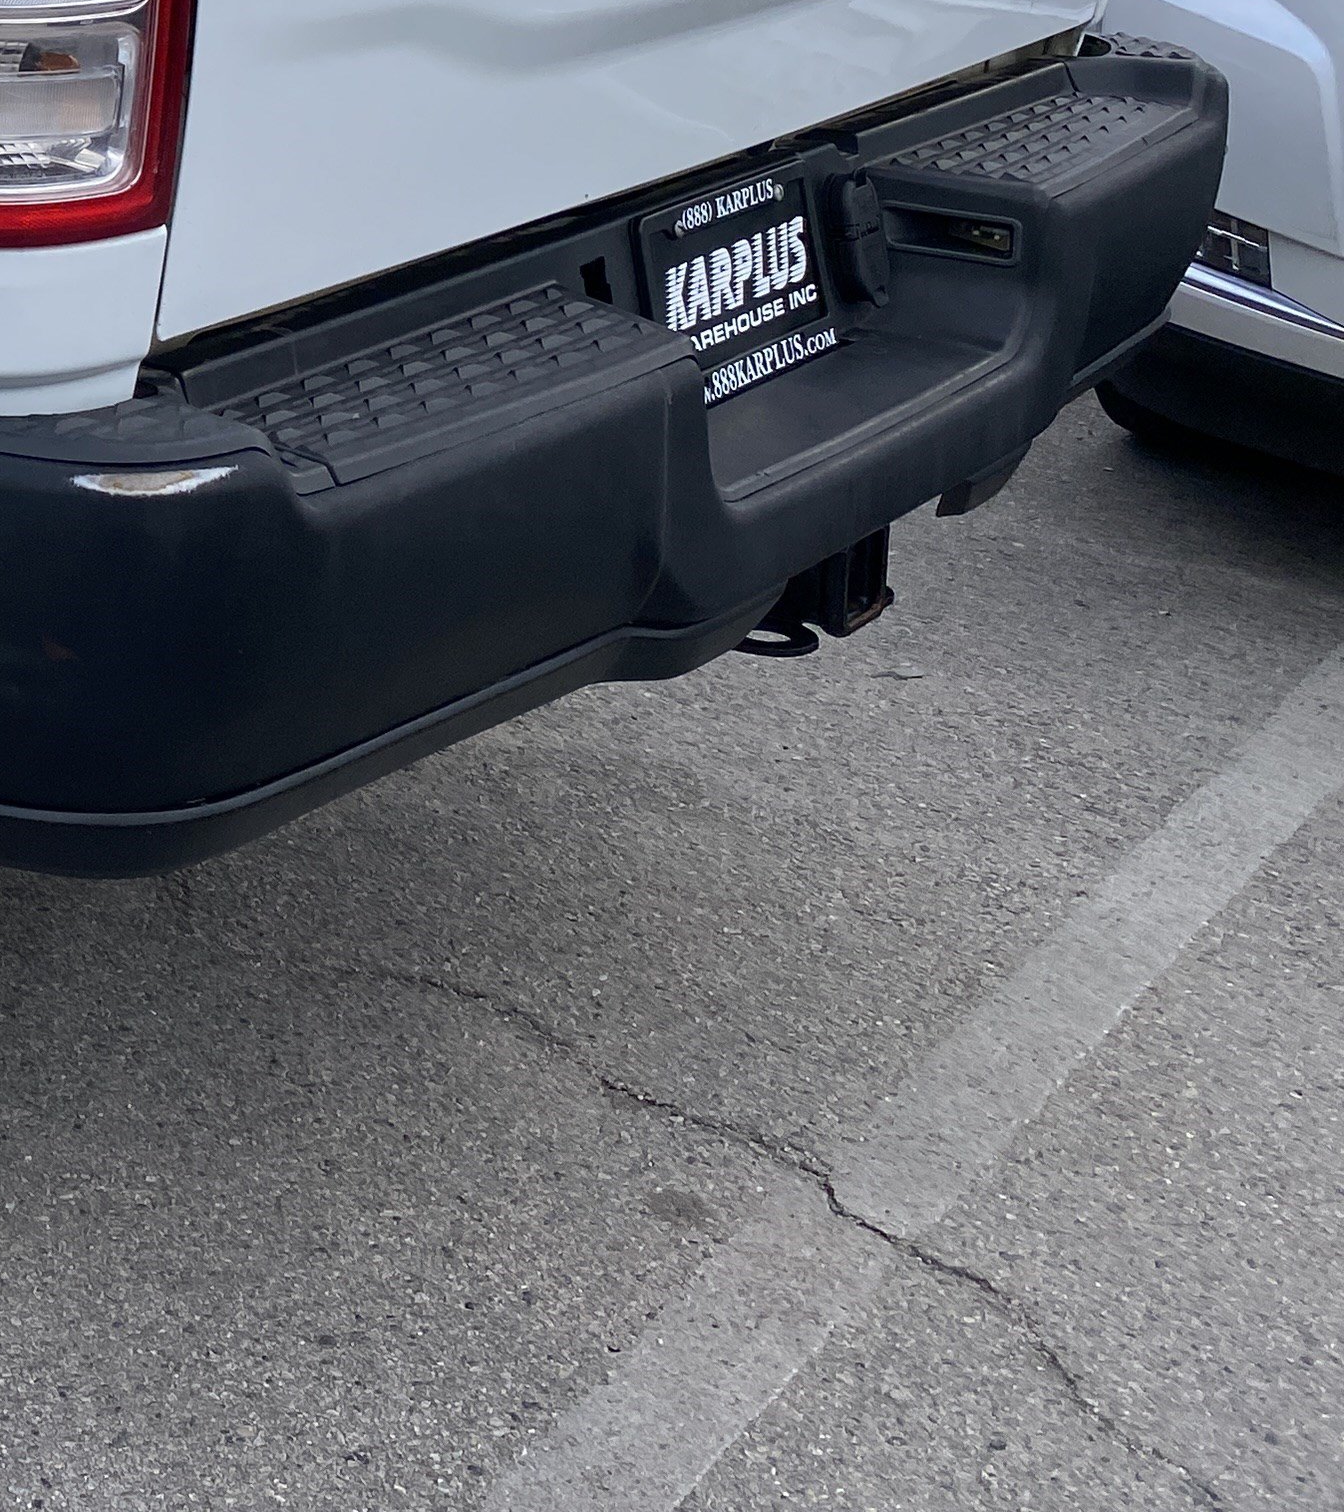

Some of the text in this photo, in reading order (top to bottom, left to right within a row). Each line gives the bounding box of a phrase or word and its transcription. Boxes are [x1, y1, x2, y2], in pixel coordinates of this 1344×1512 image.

[682, 178, 773, 230] (888) KARPLUS
[665, 216, 807, 331] KARPLUS
[789, 284, 818, 309] INC
